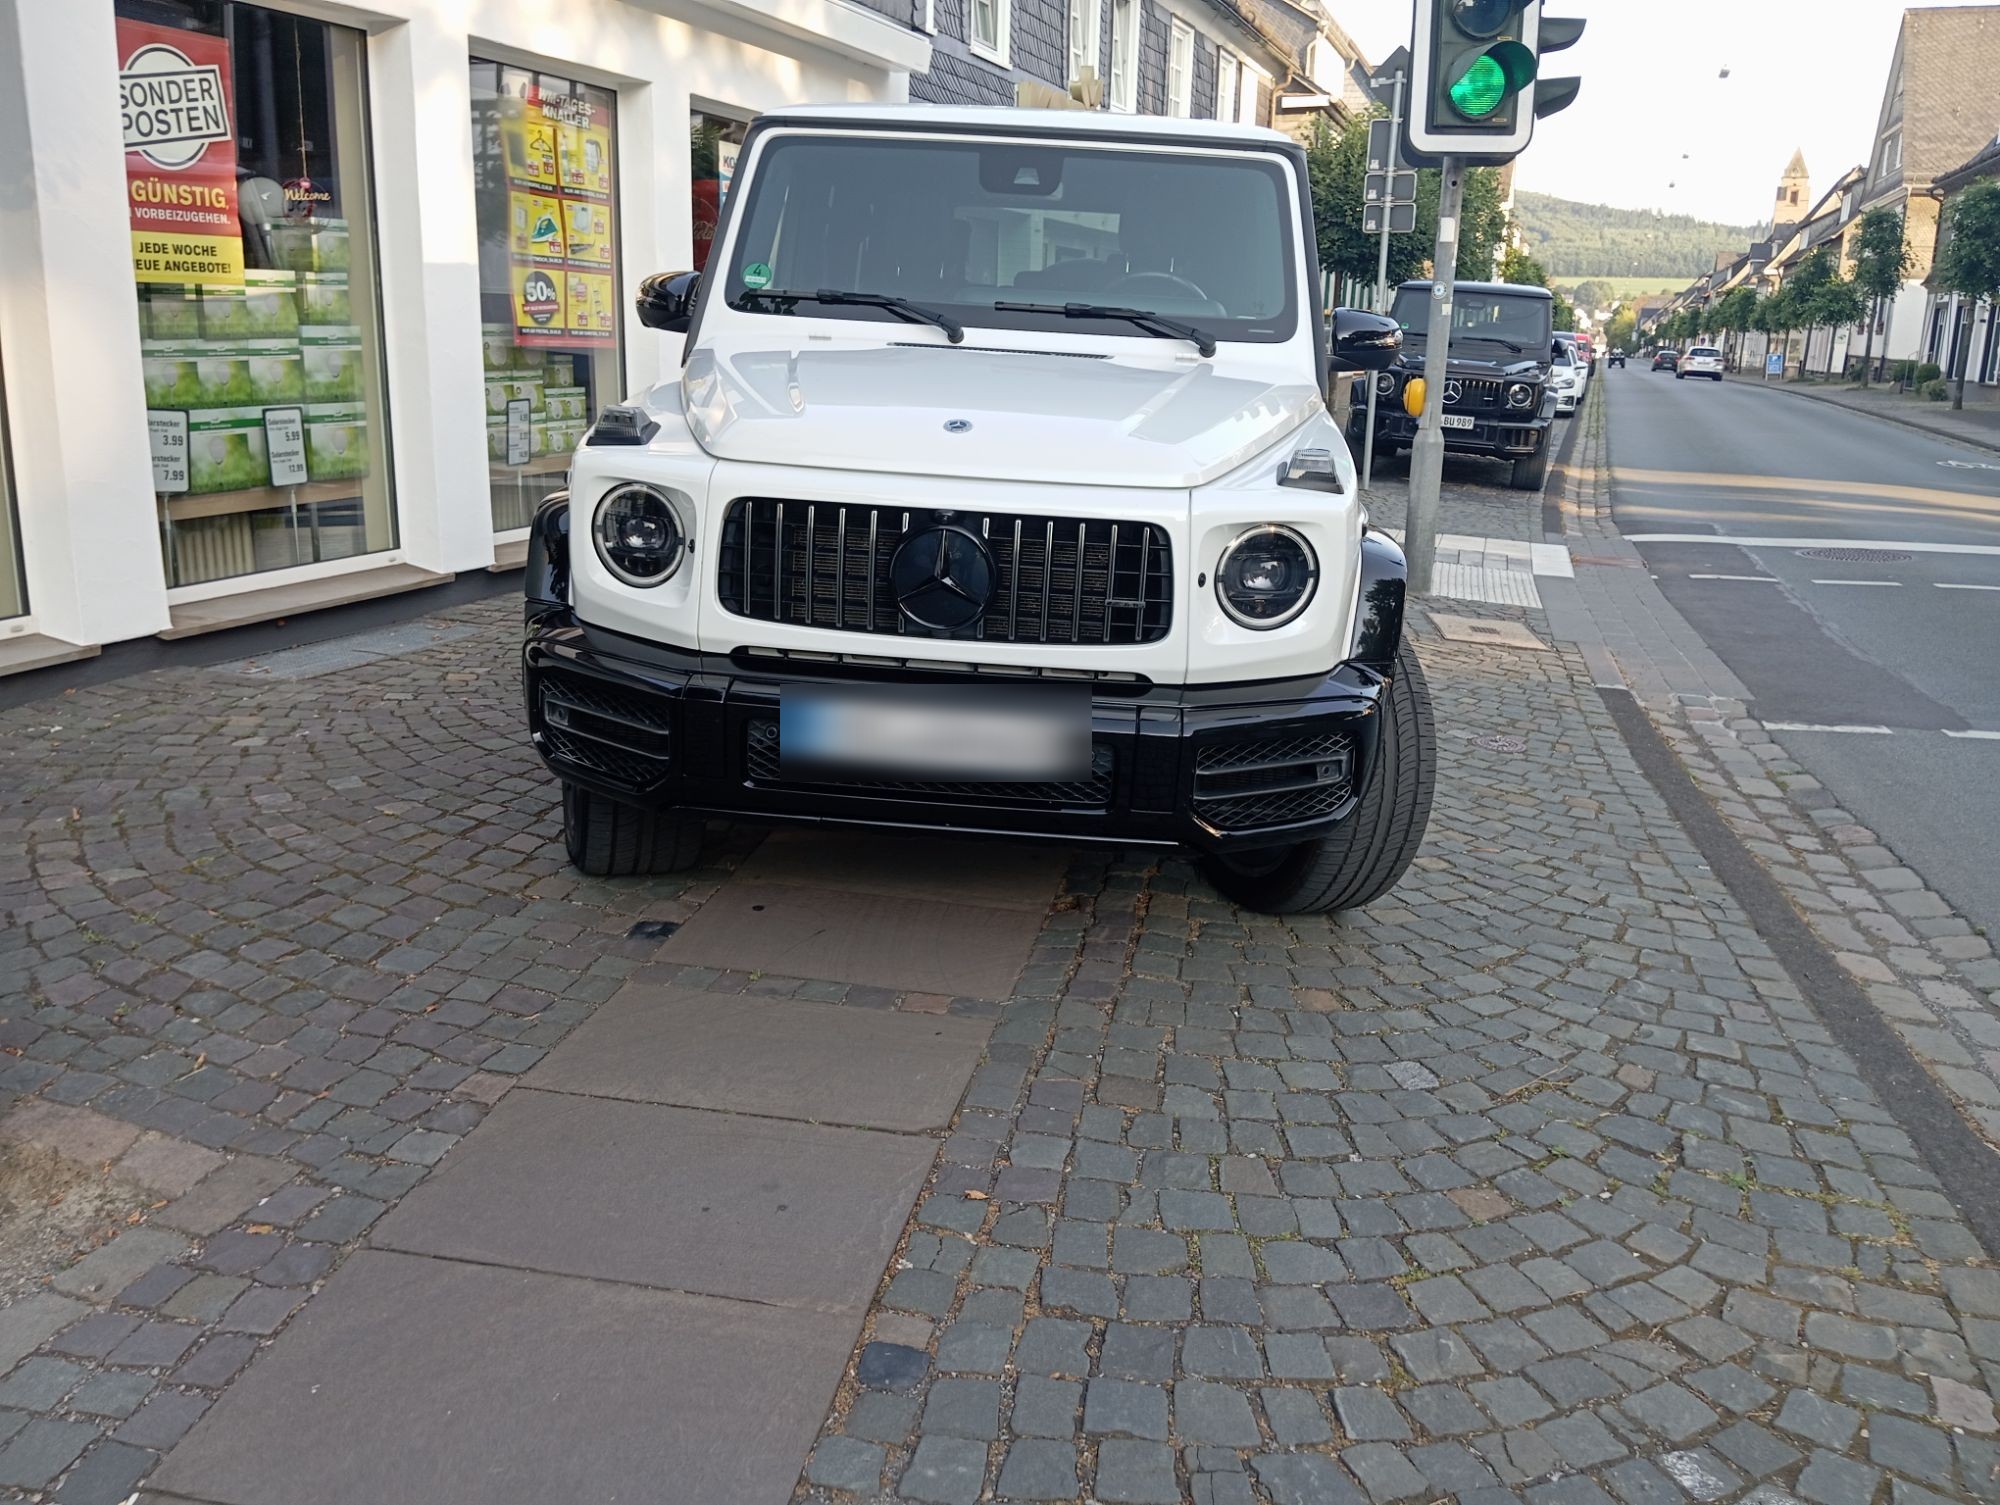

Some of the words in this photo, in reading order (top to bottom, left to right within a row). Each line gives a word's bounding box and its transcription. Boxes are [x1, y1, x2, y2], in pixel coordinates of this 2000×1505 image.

[120, 77, 215, 110] SONDER
[122, 104, 221, 138] POSTEN
[542, 103, 590, 129] KNALLER
[723, 154, 738, 169] KO
[285, 187, 331, 201] Welcome
[135, 207, 231, 224] VORBEIZUGEHEN.
[138, 242, 170, 255] JEDE
[172, 243, 218, 257] WOCHE
[134, 258, 161, 271] EUE
[164, 260, 232, 274] ANGEBOTE!
[753, 263, 762, 277] 4
[148, 419, 181, 428] arstecker
[162, 434, 184, 447] 3.99
[163, 469, 185, 482] 7.99
